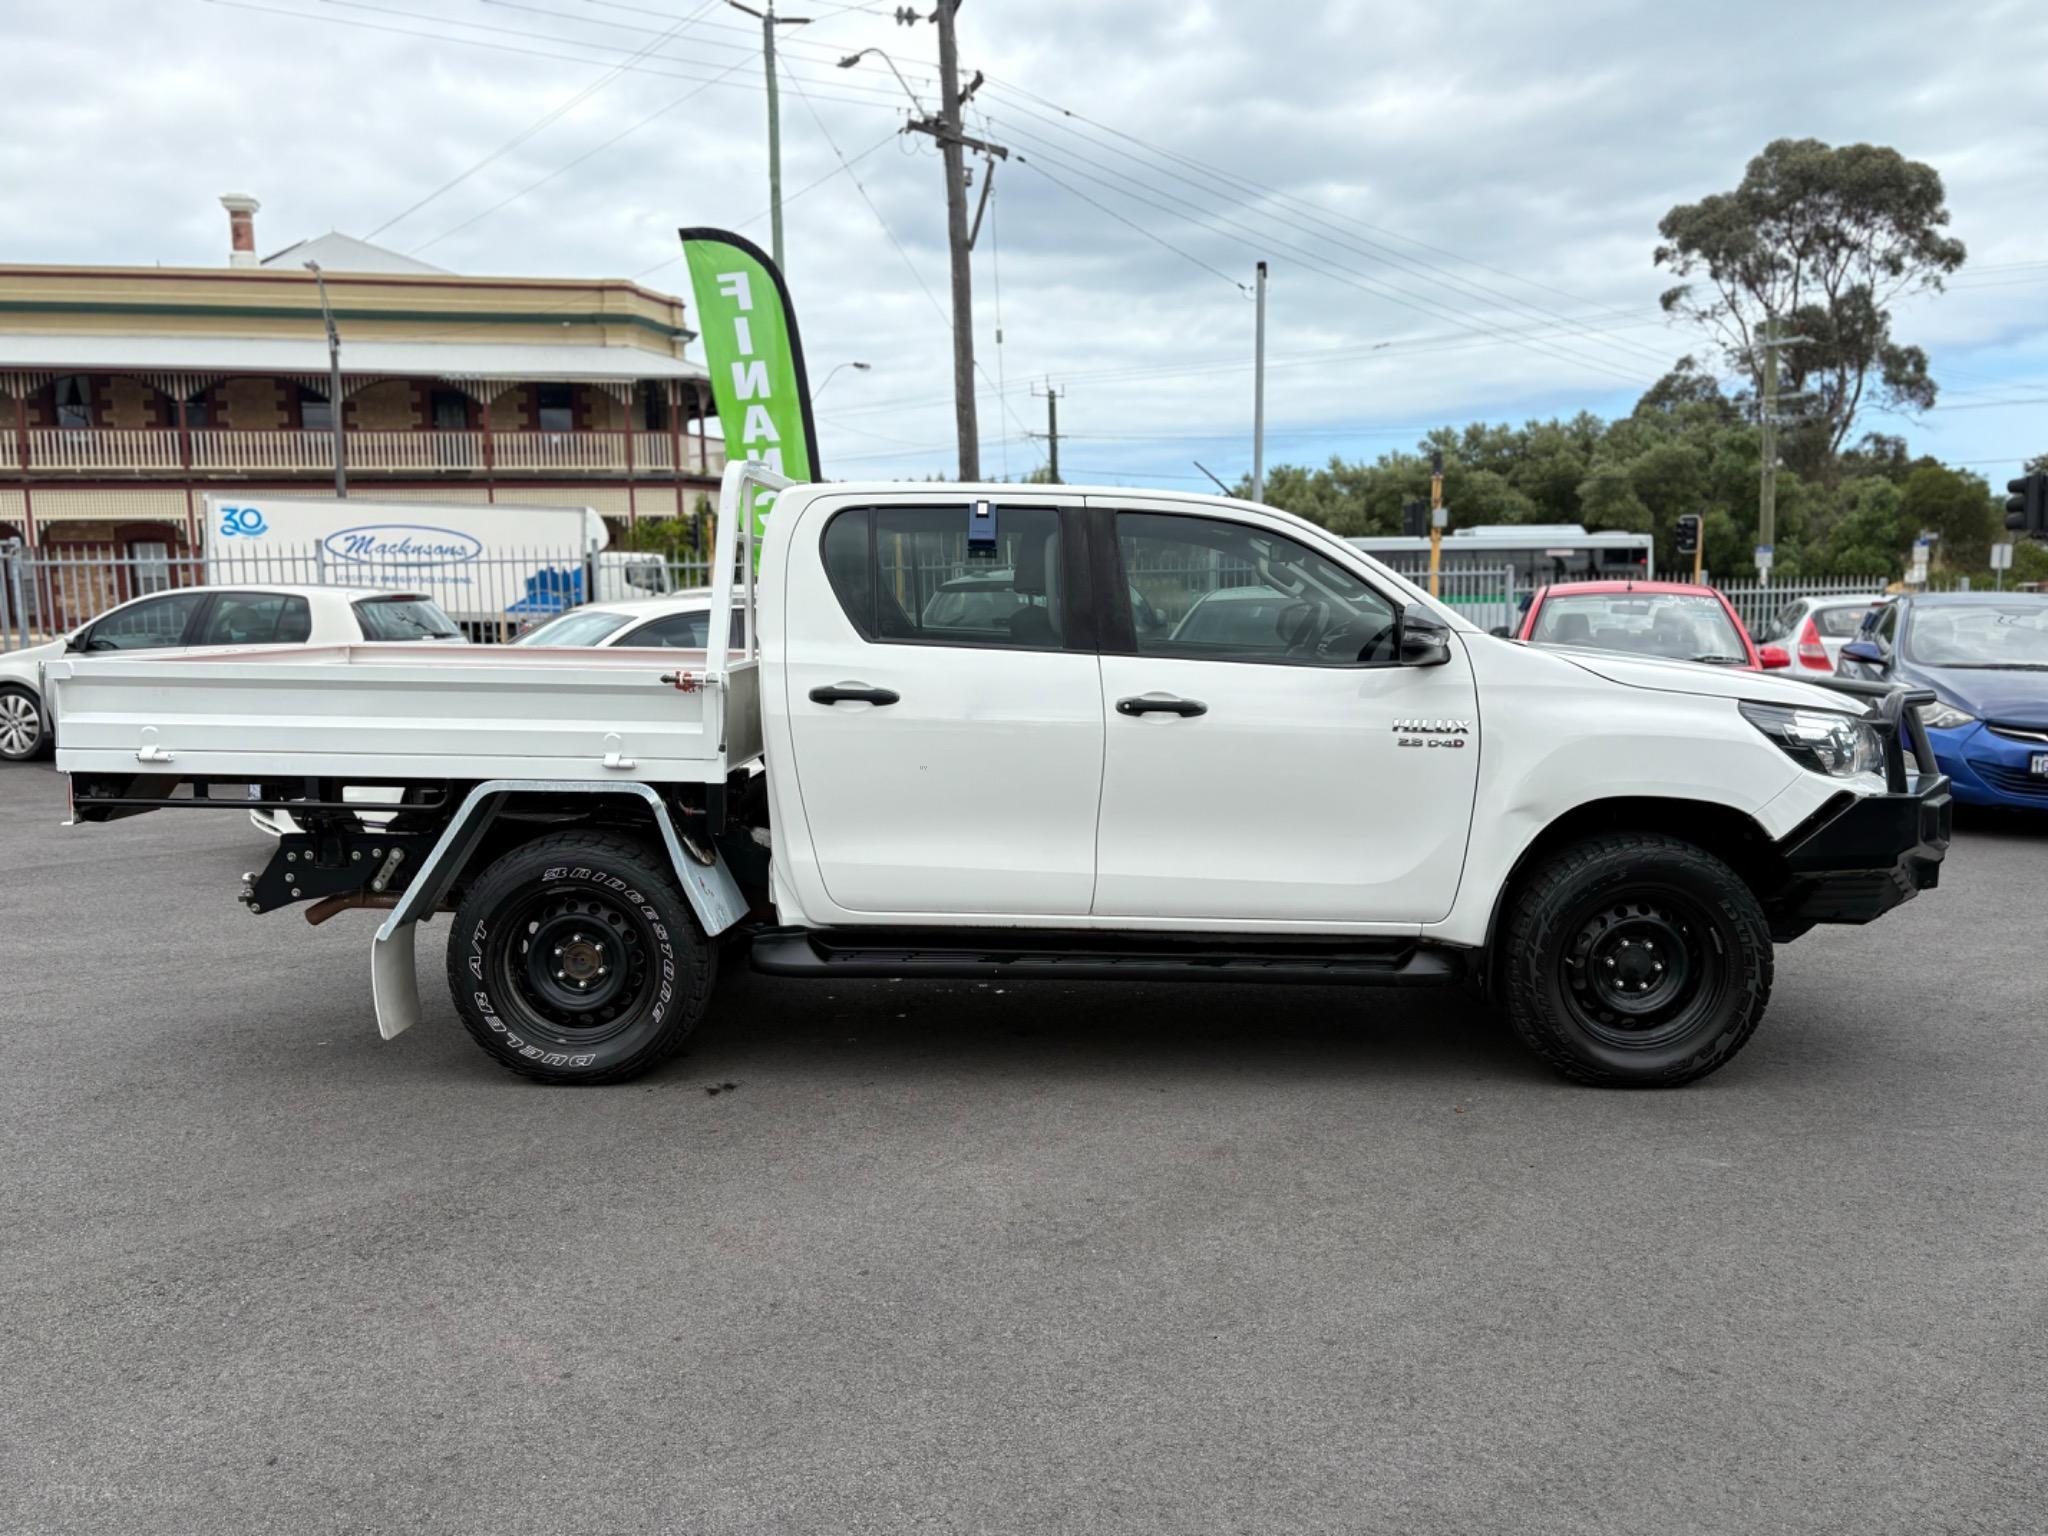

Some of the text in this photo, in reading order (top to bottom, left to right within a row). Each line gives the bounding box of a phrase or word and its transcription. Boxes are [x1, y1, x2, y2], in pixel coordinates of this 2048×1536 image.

[220, 507, 263, 536] 30
[344, 534, 466, 556] Macknsons
[1392, 718, 1470, 734] HILUX
[542, 867, 675, 1024] BRIDGESTONE
[468, 919, 596, 1067] DUELER A/T
